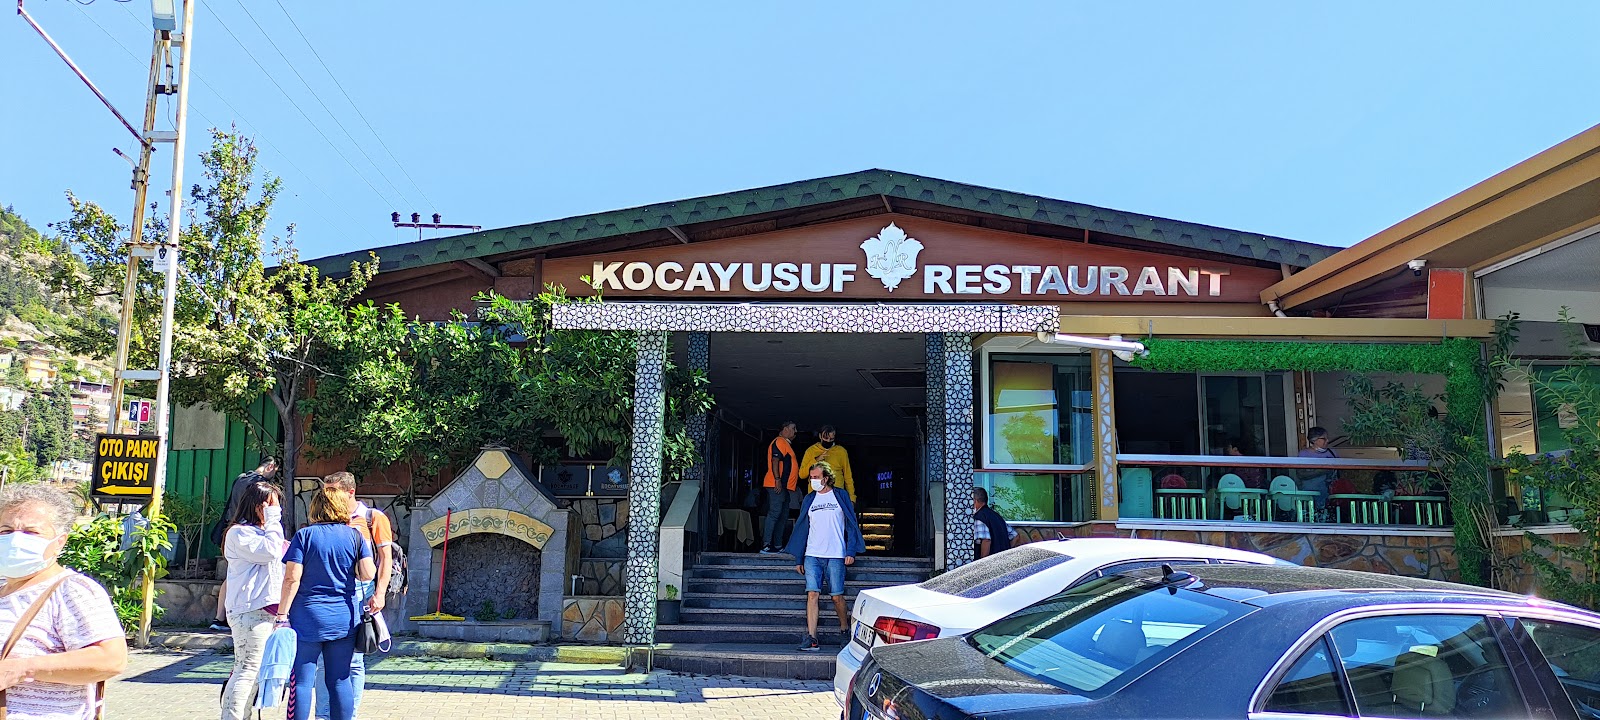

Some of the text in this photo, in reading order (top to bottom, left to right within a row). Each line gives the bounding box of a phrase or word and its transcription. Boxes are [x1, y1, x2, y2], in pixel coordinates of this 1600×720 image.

[593, 261, 1231, 296] KOCAYUSUF RESTAURANT
[99, 438, 158, 458] OTO PARK
[101, 461, 149, 485] ÇIKIŞI
